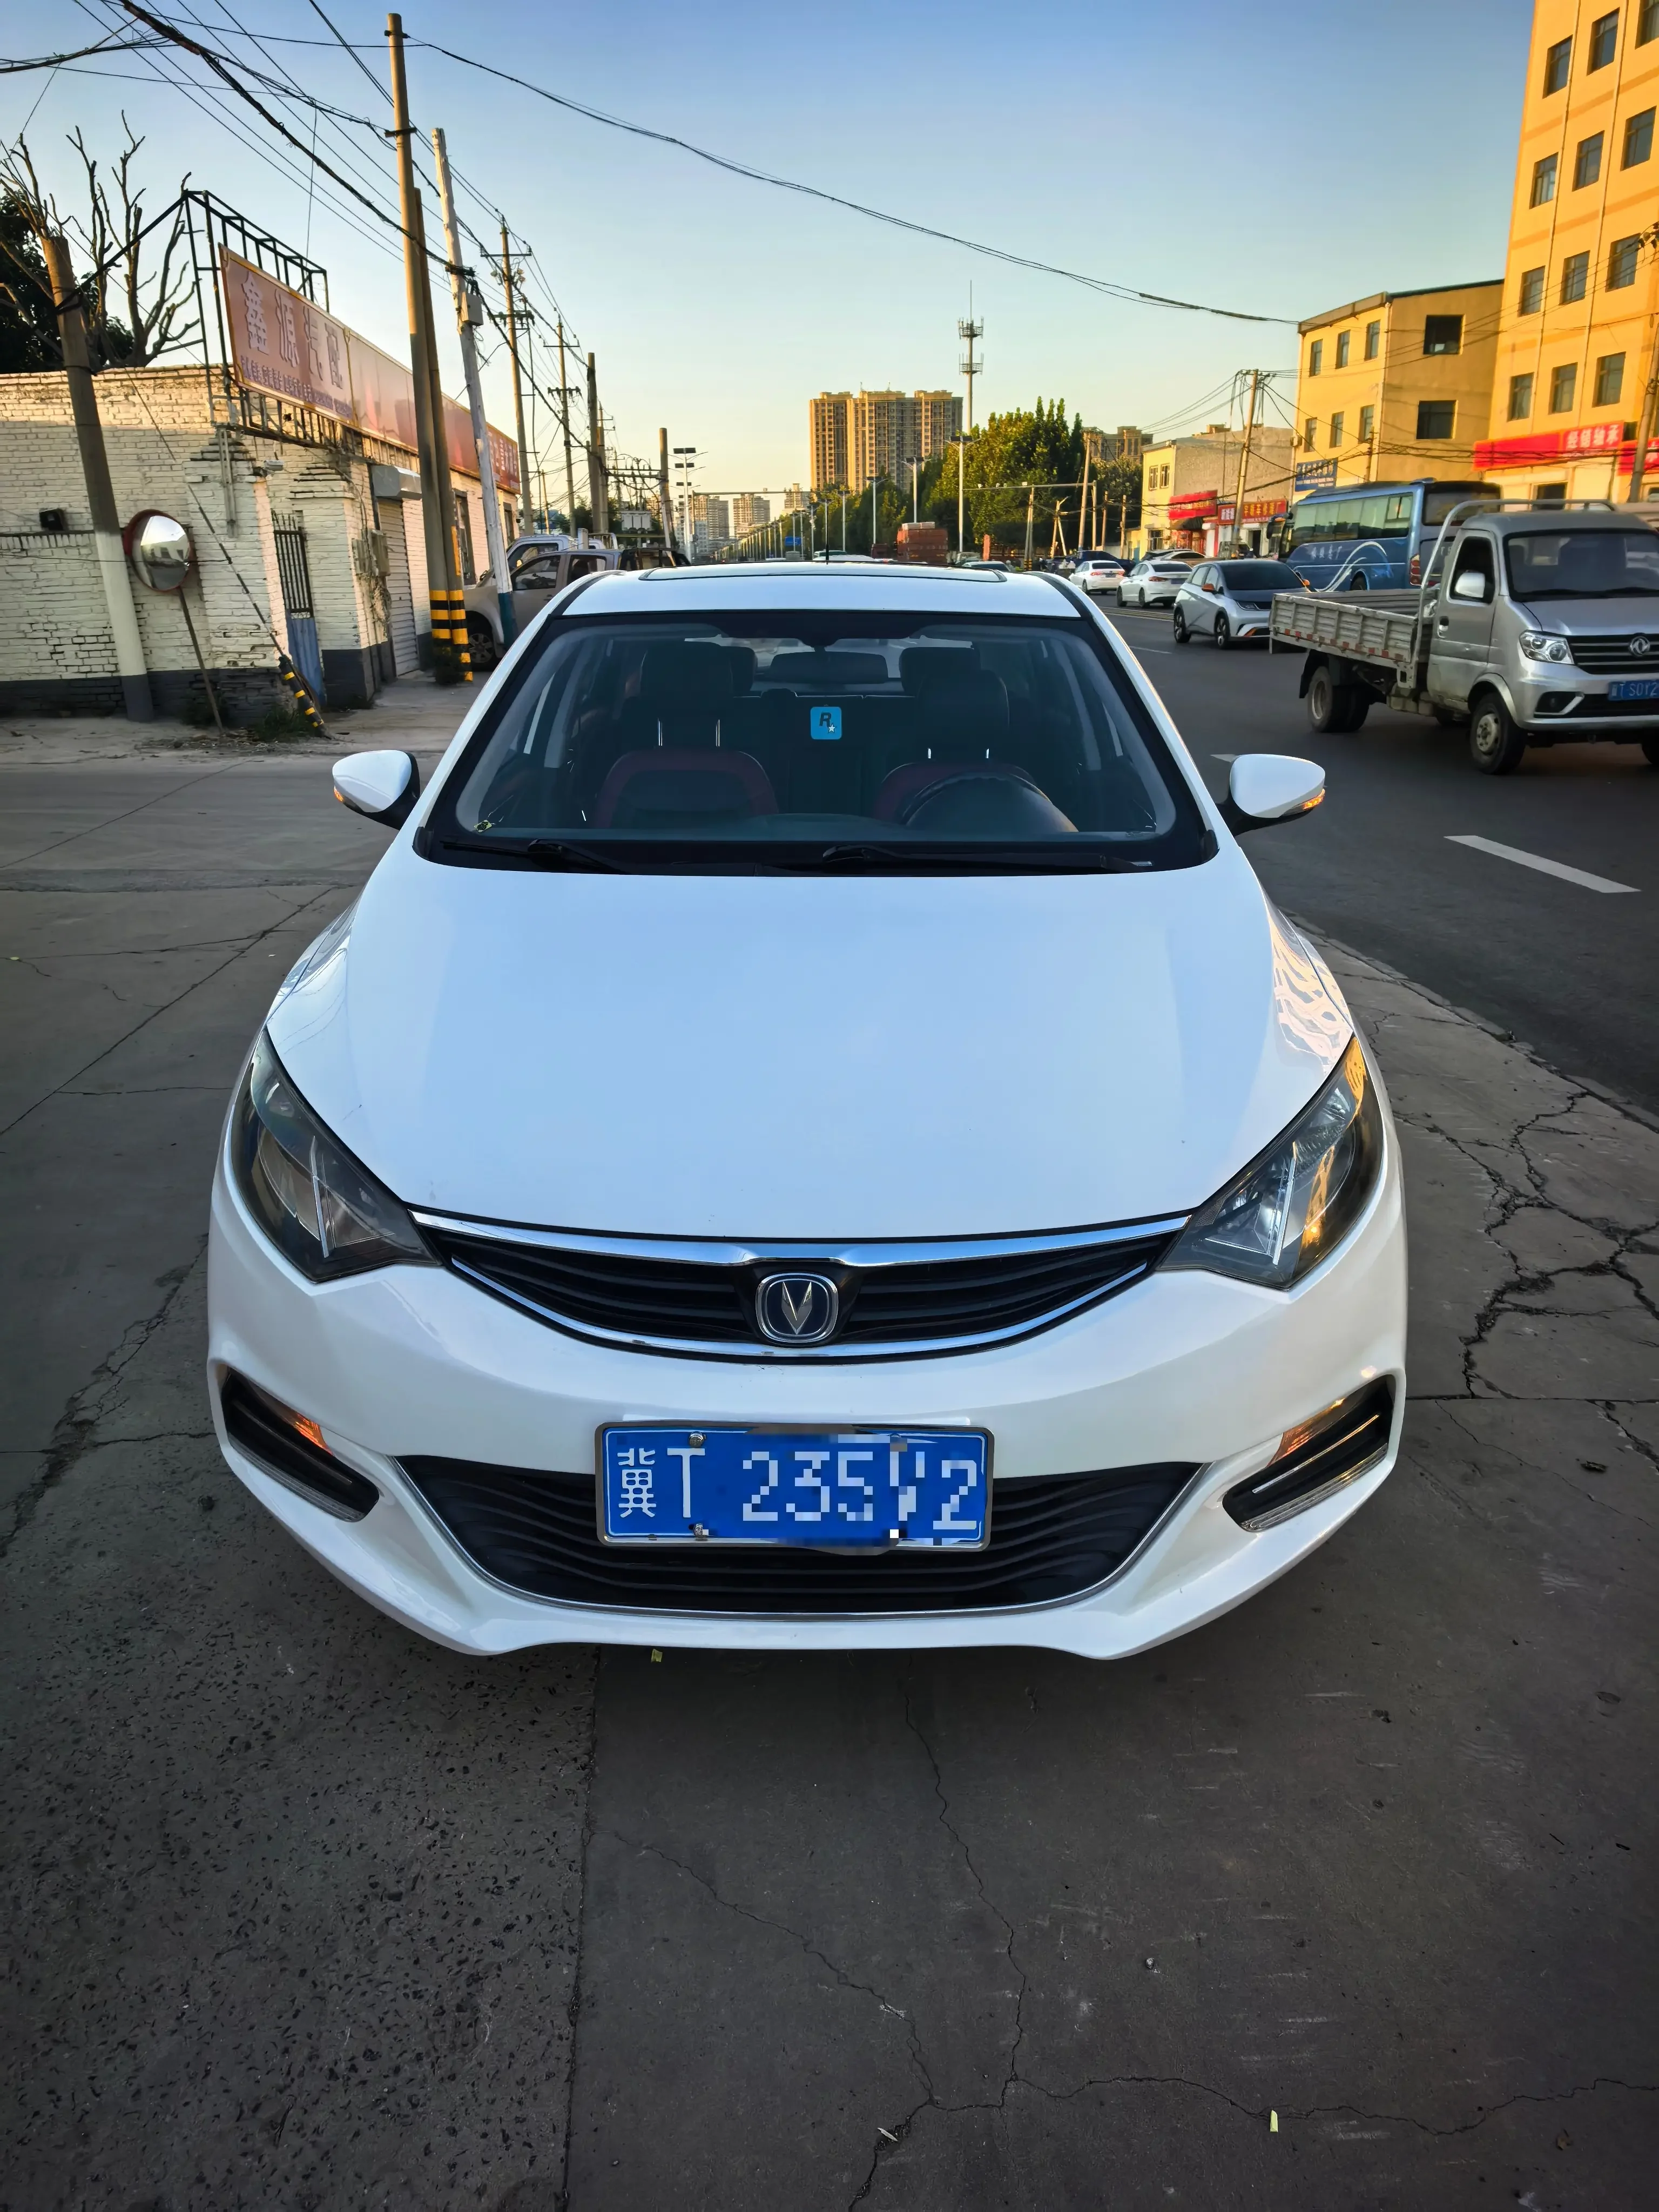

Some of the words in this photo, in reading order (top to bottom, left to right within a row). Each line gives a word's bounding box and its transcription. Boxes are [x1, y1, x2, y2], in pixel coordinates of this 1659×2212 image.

[241, 271, 343, 390] 鑫源汽配
[617, 1447, 705, 1519] 冀T
